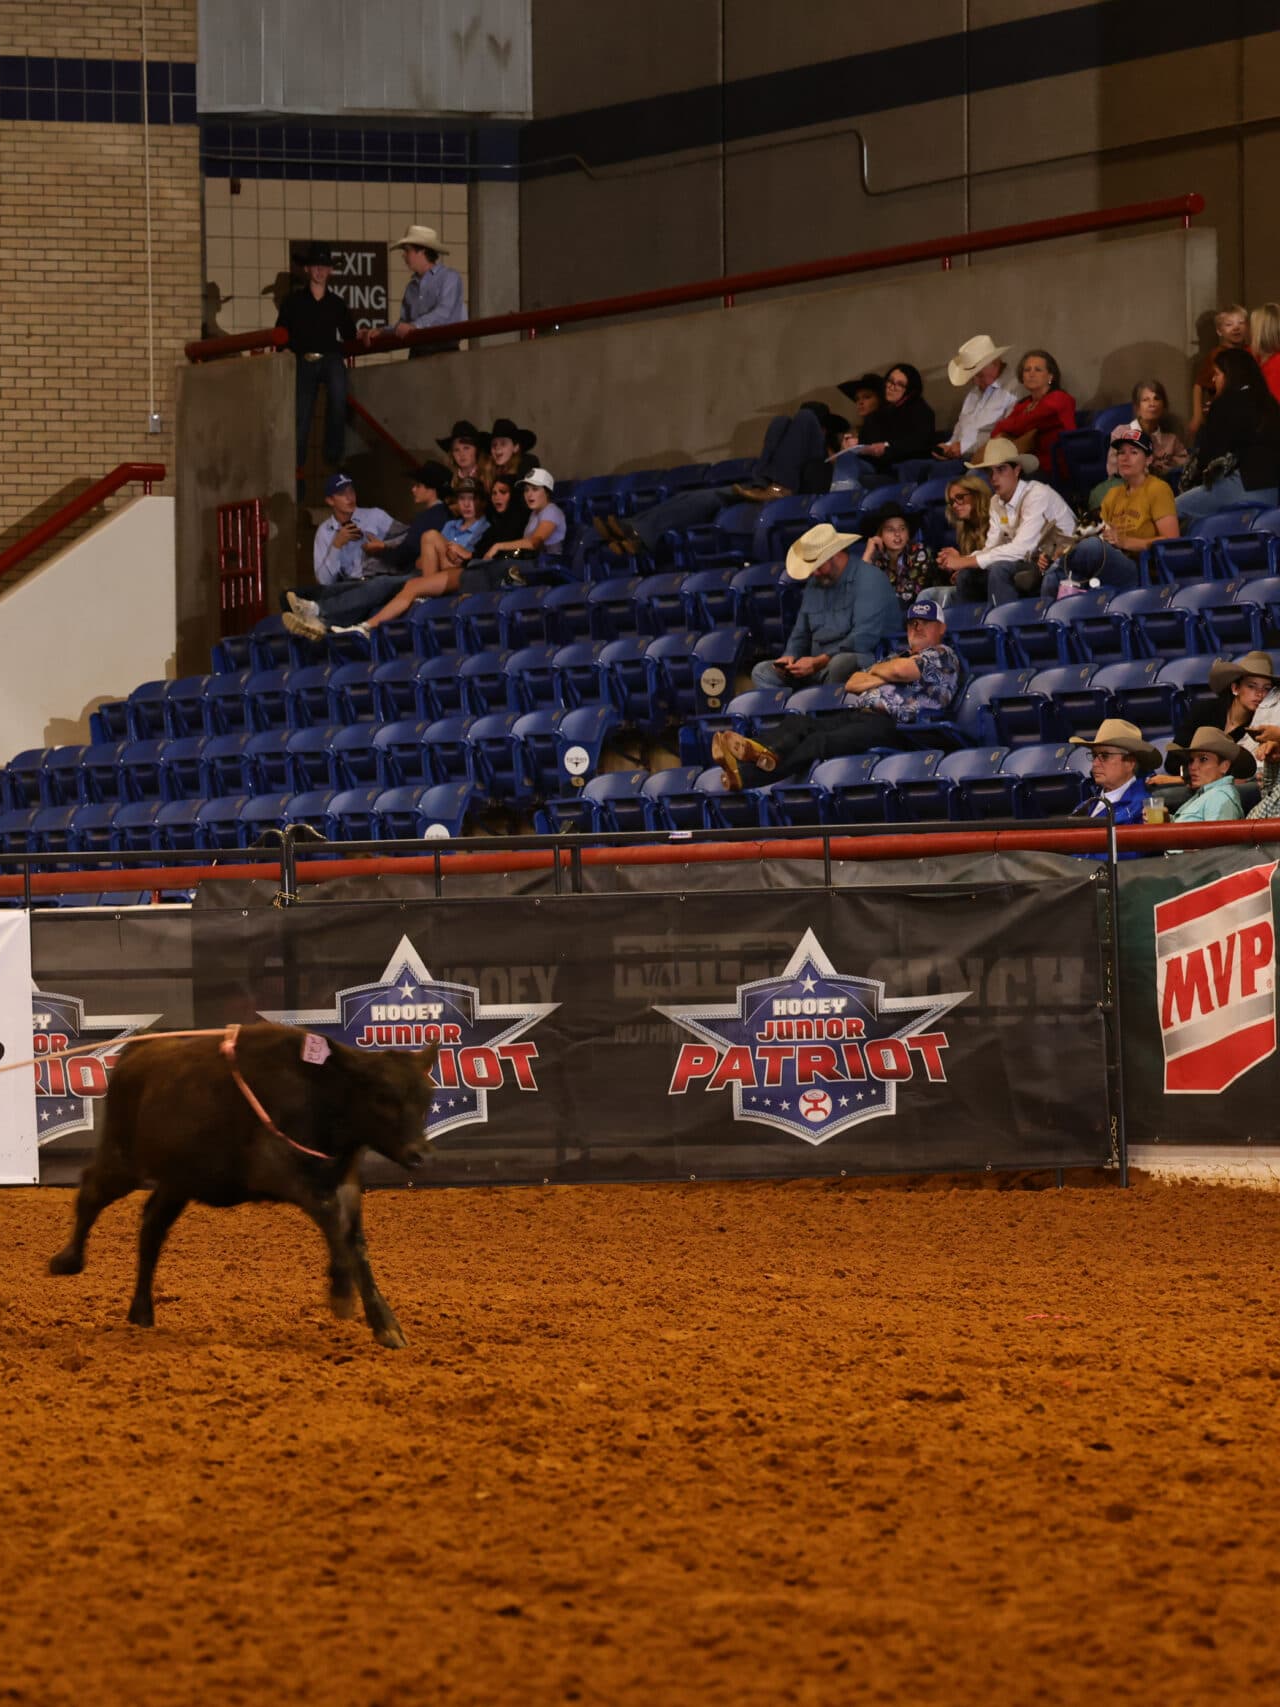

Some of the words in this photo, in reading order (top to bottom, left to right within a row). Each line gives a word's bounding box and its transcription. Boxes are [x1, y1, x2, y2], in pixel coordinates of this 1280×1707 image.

[1162, 921, 1273, 1030] MVP
[371, 1003, 444, 1021] HOOEY
[772, 997, 848, 1016] HOOEY
[356, 1023, 462, 1047] JUNIOR
[756, 1017, 866, 1042] JUNIOR
[668, 1032, 949, 1095] PATRIOT
